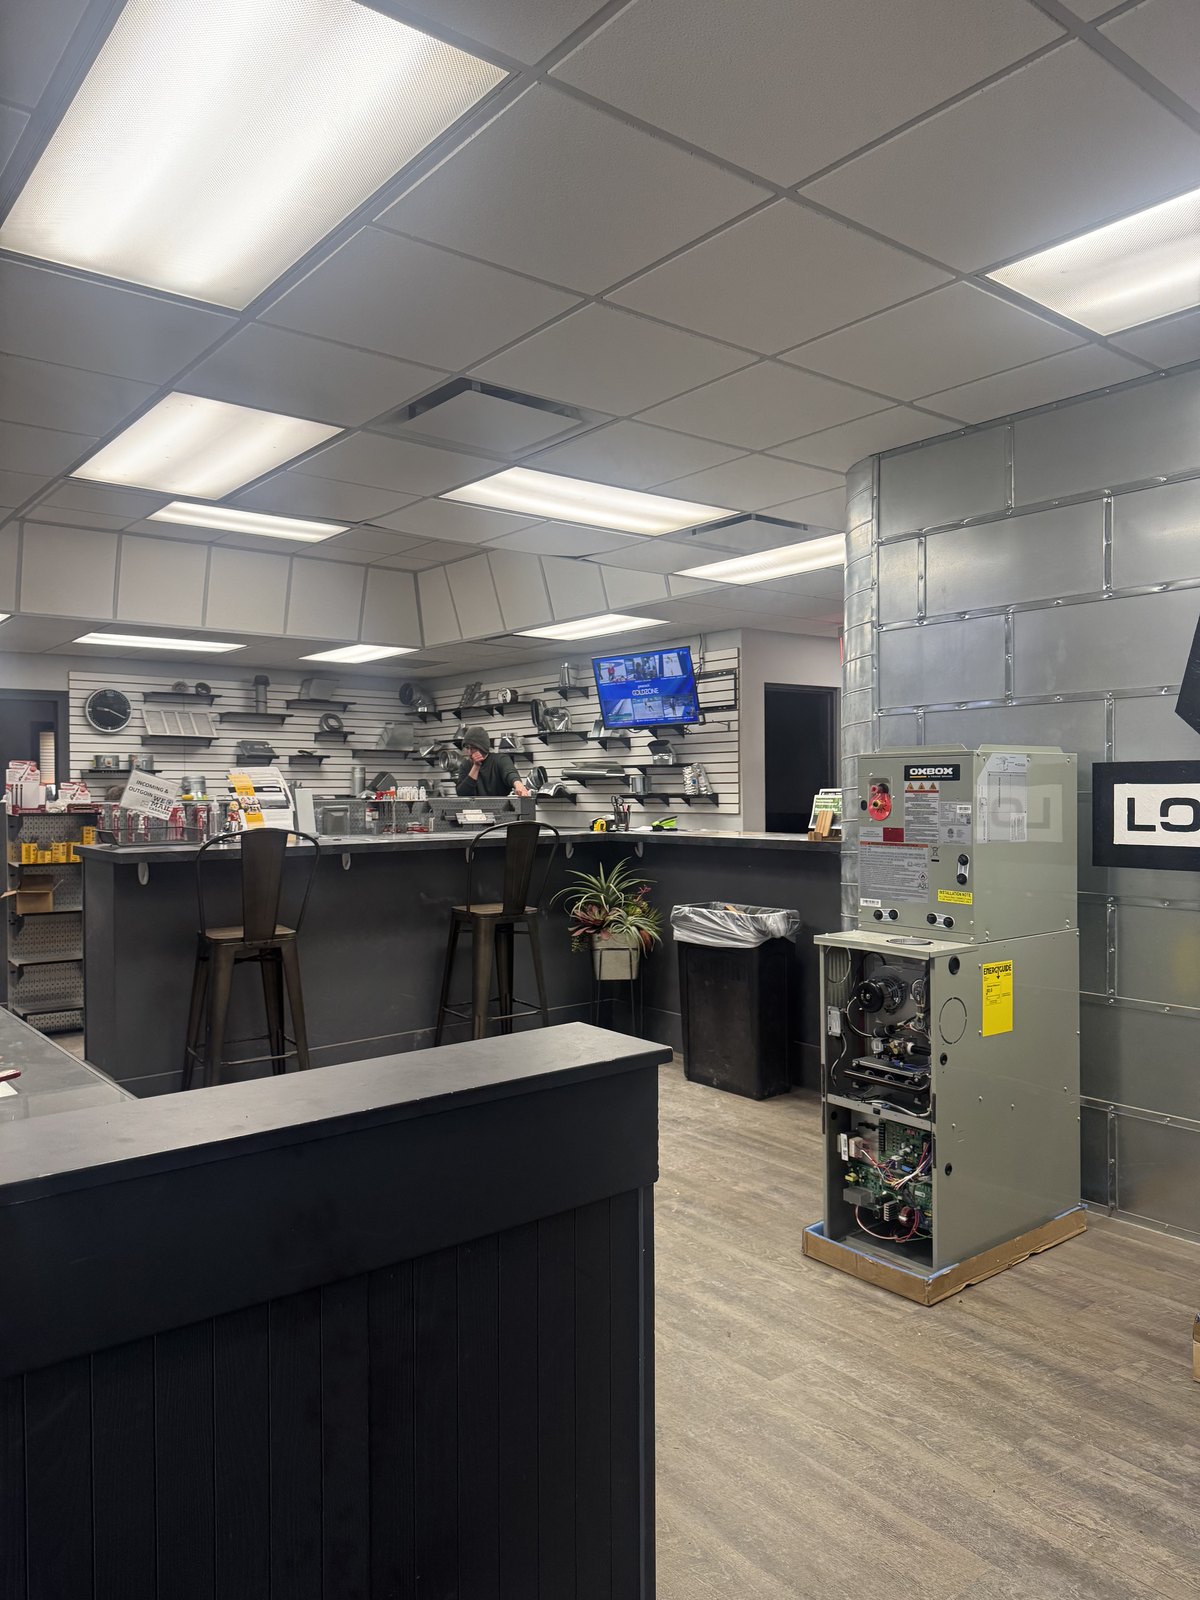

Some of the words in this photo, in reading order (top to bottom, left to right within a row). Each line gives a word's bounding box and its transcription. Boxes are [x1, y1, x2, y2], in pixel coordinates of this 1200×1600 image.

[909, 767, 953, 775] OXBOX
[136, 780, 164, 792] INCOMING
[128, 786, 153, 798] OUTGOIN
[153, 795, 166, 804] WE
[150, 801, 171, 812] MAIL
[983, 964, 1012, 975] ENERGYGUIDE
